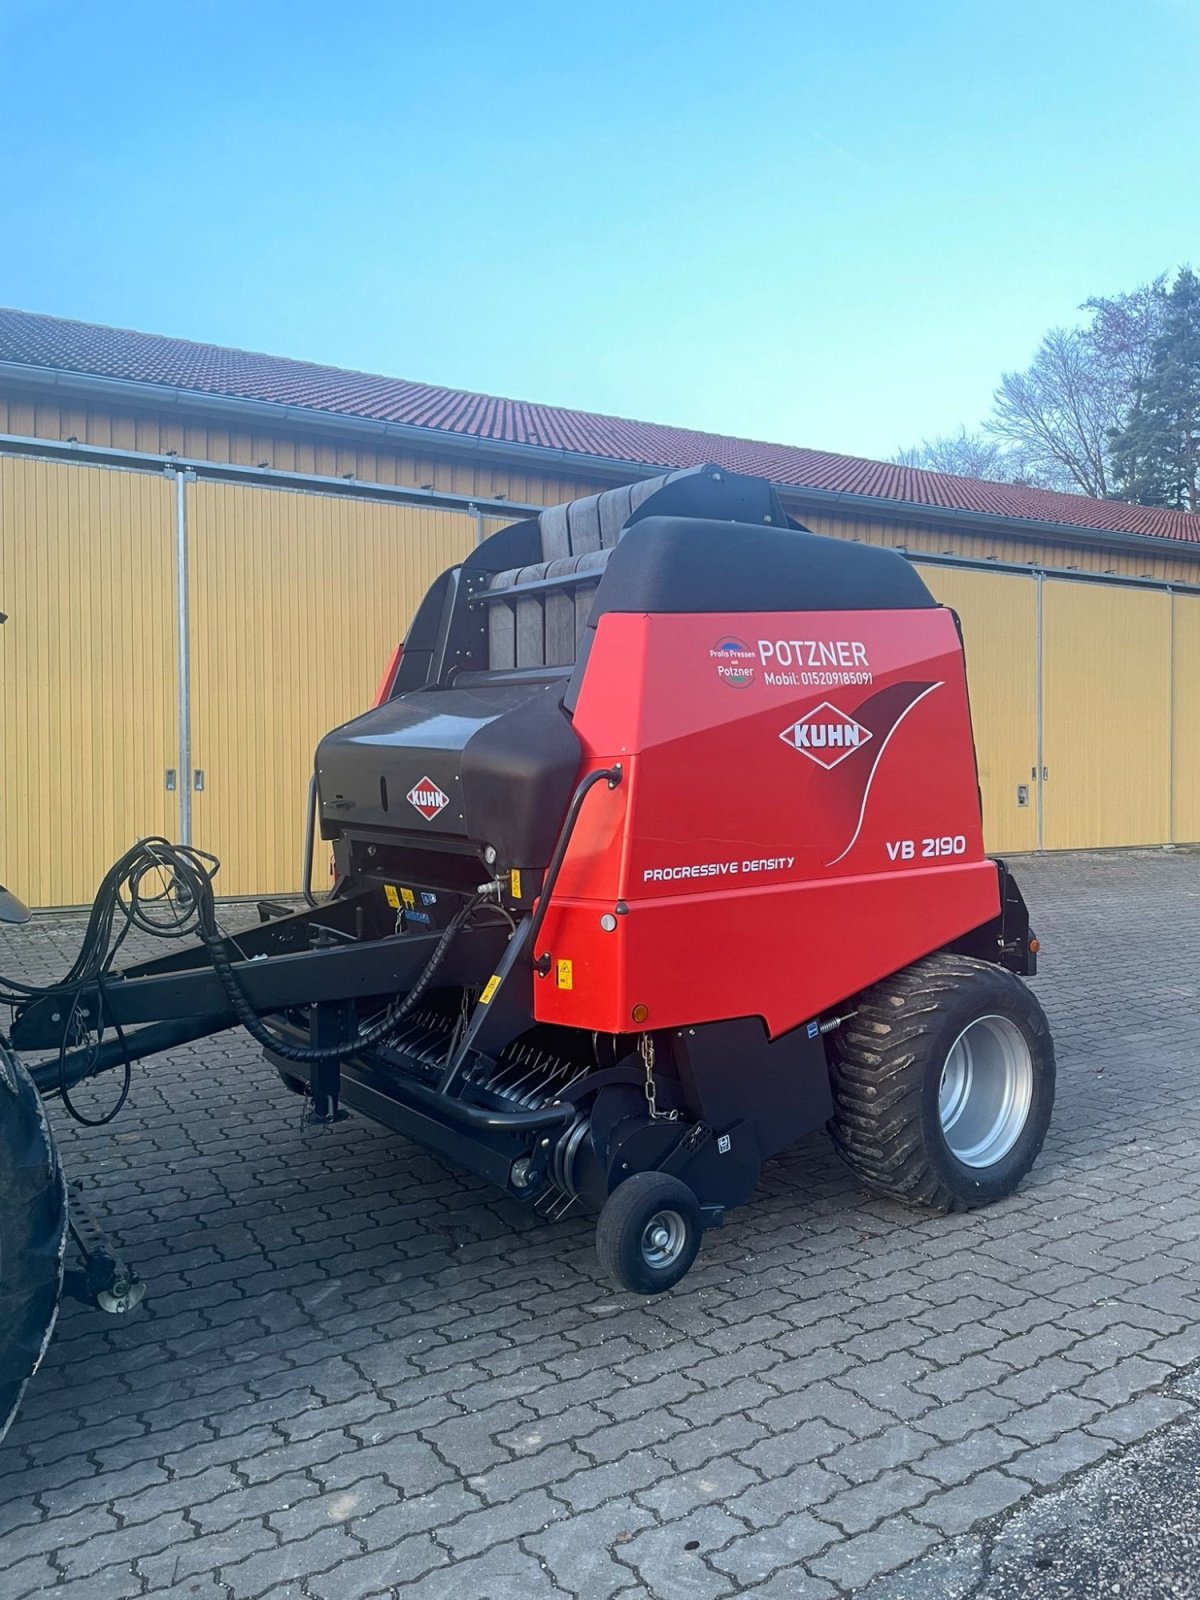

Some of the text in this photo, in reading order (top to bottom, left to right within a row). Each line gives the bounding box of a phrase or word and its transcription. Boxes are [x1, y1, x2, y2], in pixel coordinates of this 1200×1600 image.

[730, 650, 756, 658] Pressen
[757, 640, 869, 666] POTZNER
[717, 665, 754, 677] Potzner
[764, 672, 873, 685] Mobil: 015209185091
[793, 724, 861, 748] KUHN
[411, 790, 444, 808] KUHN
[885, 835, 967, 861] VB 2190
[643, 856, 795, 882] PROGRESSIVE DENSITY
